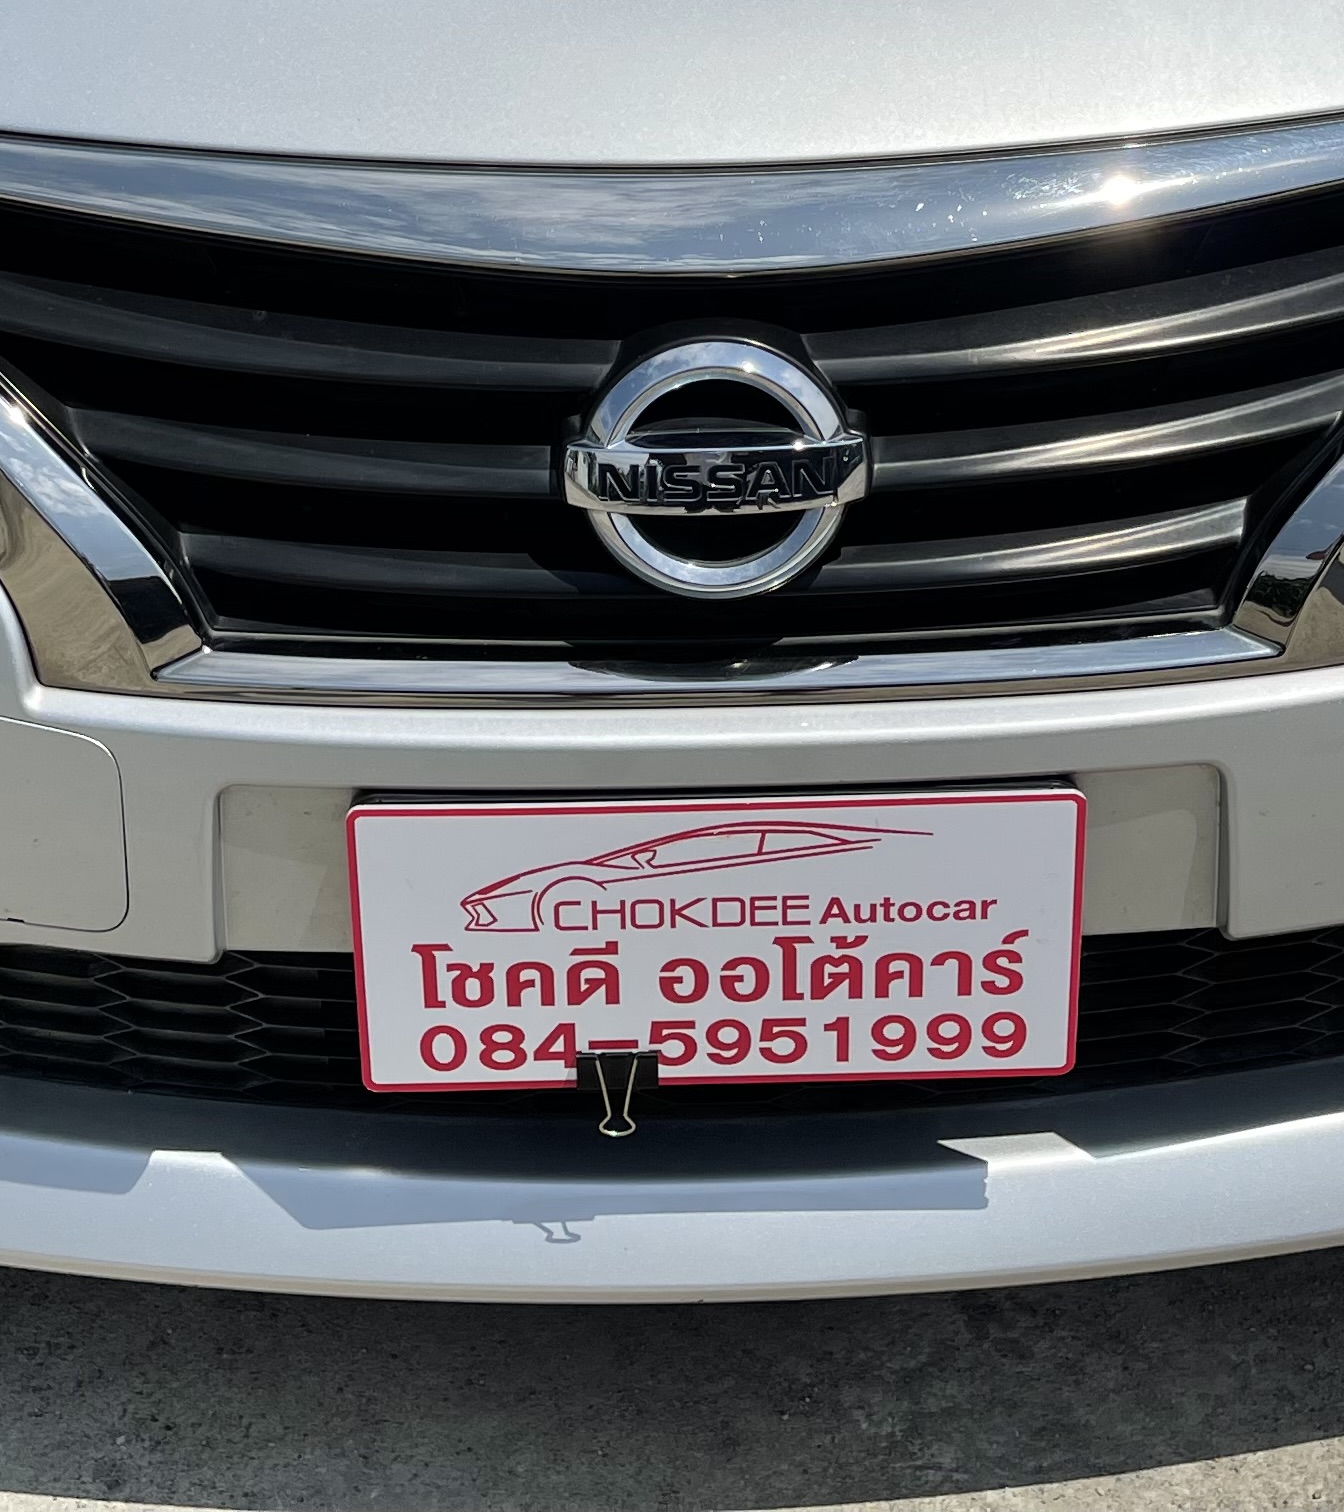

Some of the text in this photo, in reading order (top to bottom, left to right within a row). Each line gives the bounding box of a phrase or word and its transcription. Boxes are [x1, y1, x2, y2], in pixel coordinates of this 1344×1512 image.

[597, 456, 837, 503] NISSAN
[553, 894, 997, 931] CHOKDEE Autocar
[411, 929, 1029, 1009] โชคดี ออโต้คาร์
[419, 1011, 1028, 1072] 084-5951999
